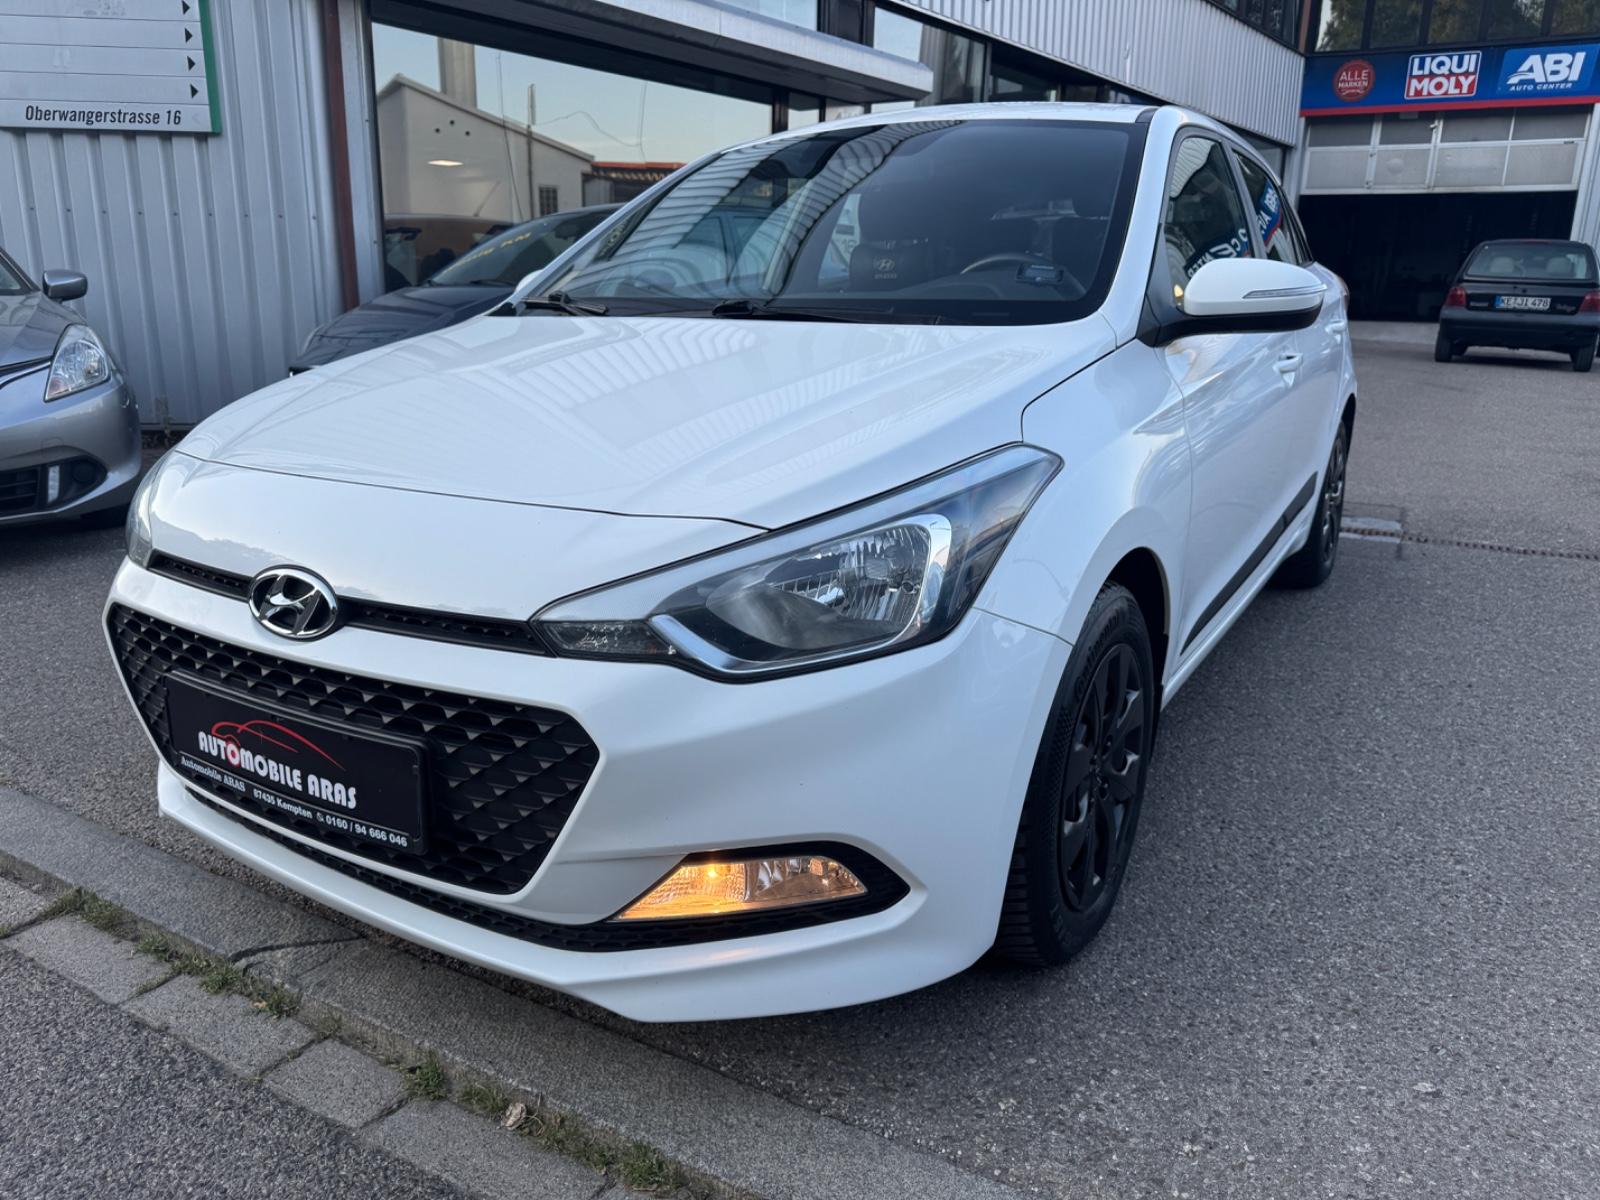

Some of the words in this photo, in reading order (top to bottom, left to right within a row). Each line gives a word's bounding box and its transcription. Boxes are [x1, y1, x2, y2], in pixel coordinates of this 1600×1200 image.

[1339, 69, 1369, 82] ALLE
[1411, 54, 1476, 76] LIQUI
[1506, 52, 1586, 84] ABI
[1338, 80, 1369, 90] MARKEN
[1409, 74, 1475, 97] MOLY
[1509, 84, 1534, 92] AUTO
[1536, 82, 1573, 90] CENTER
[25, 105, 160, 125] Oberwangerstrasse
[166, 110, 181, 125] 16
[198, 731, 303, 792] AUTOMOBILE
[307, 774, 357, 810] ARAS
[181, 756, 222, 783] Automobile
[223, 774, 246, 792] ARAS
[253, 789, 276, 806] 87435
[276, 798, 313, 820] Kempten
[326, 815, 348, 831] 0160
[355, 823, 367, 836] 94
[369, 828, 387, 842] 666
[389, 832, 408, 848] 046
